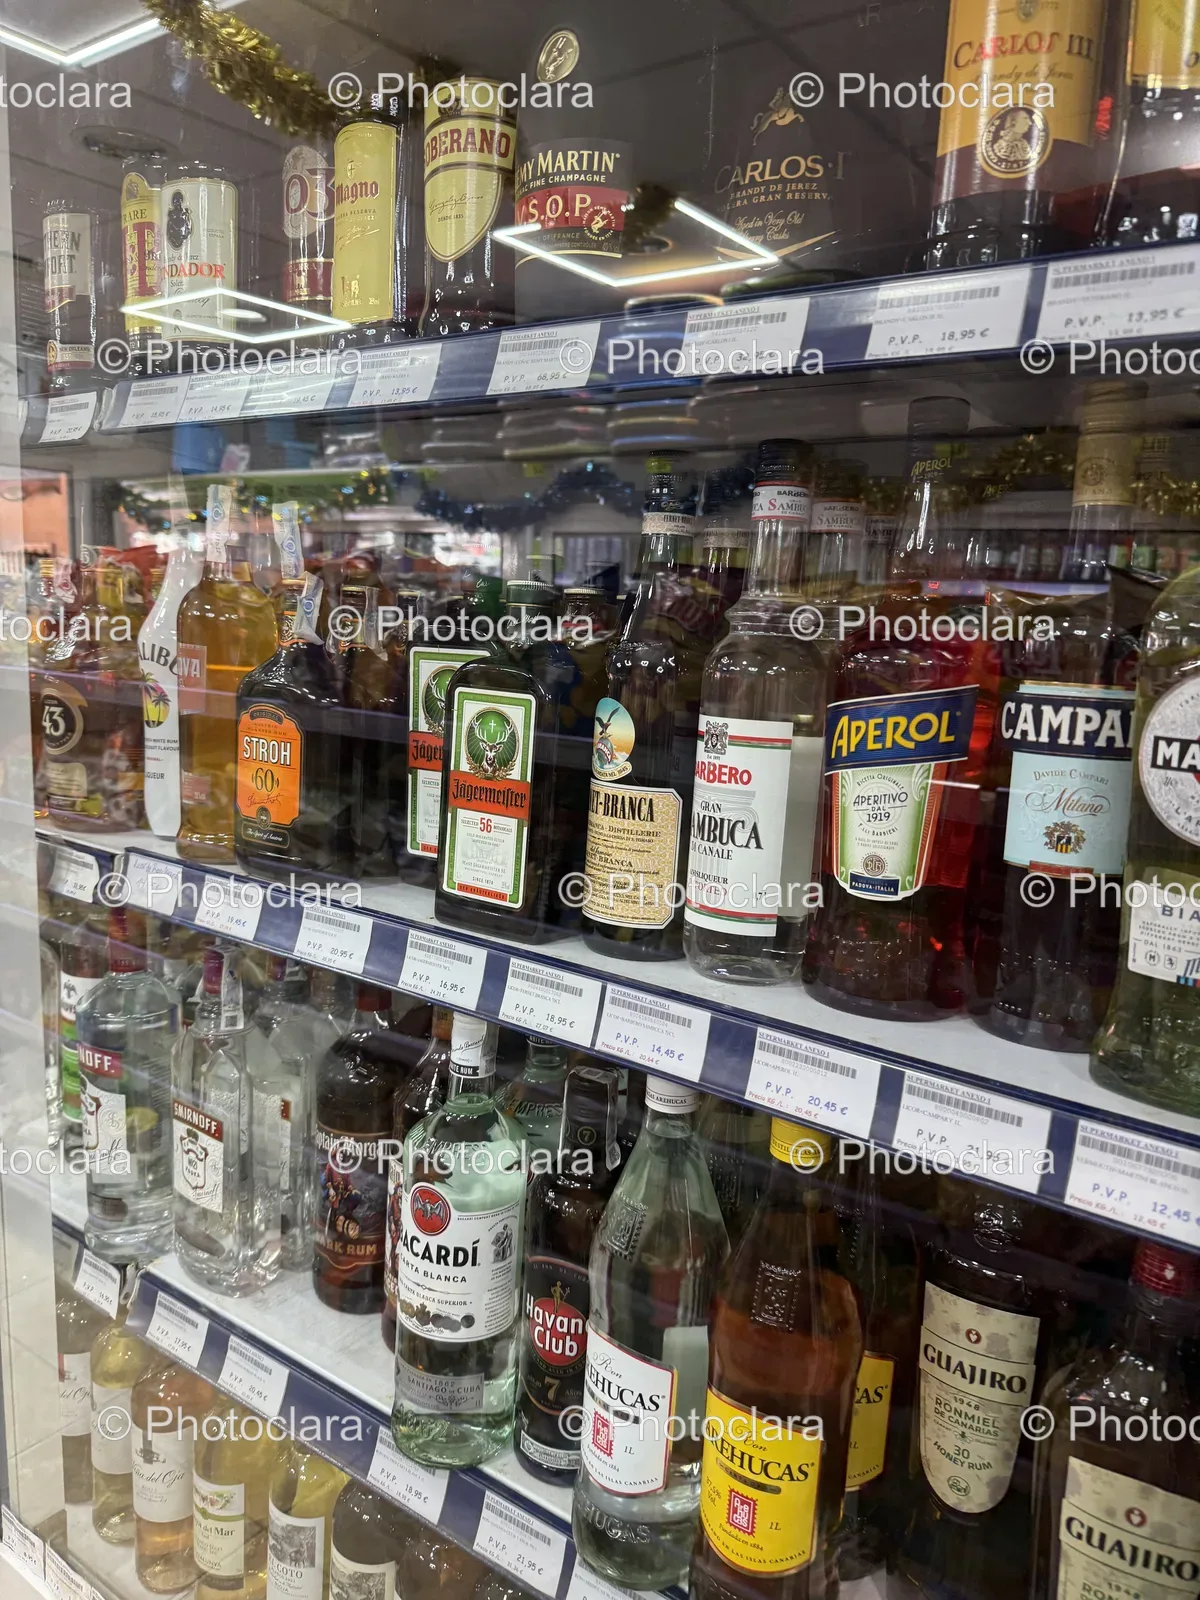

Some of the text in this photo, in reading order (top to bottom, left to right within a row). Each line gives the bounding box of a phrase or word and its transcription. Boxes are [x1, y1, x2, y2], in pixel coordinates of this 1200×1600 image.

[953, 31, 1095, 69] CARLOS III
[424, 127, 511, 166] OBERANO
[537, 150, 615, 176] MARTIN
[530, 173, 607, 191] FINE CHAMPAGNE
[714, 155, 825, 194] CARLOS
[730, 182, 818, 199] BRANDY DE JEREZ
[752, 193, 781, 204] GRAN
[123, 209, 148, 224] RARE
[764, 209, 805, 231] Very Old
[1064, 309, 1168, 328] P.V.P. 13,95
[888, 329, 976, 346] P.V.P. 18,95
[504, 373, 560, 383] P.V.P. 68,95
[362, 389, 381, 397] P.V.P.
[911, 457, 953, 477] APEROL
[831, 711, 956, 759] APEROL
[243, 735, 291, 766] STROH
[254, 767, 275, 793] 60
[856, 773, 904, 791] RICETTA ORIGINALE
[1033, 769, 1109, 786] DAVIDE CAMPARI
[700, 800, 722, 814] GRAN
[853, 792, 908, 807] APERITIVO
[1030, 787, 1110, 818] Milano
[461, 817, 492, 833] SELECTED 56
[867, 812, 891, 823] 1919
[608, 825, 661, 838] DISTILLERIE
[698, 844, 733, 860] CANALE
[205, 909, 221, 920] P.V.P.
[306, 940, 348, 958] P.V.P. 20,95
[1144, 939, 1159, 948] DAL
[511, 961, 561, 980] SUPERMARKET ANEXO
[412, 972, 459, 993] P.V.P. 16,95
[610, 988, 666, 1008] SUPERMARKET ANEXO
[514, 1003, 568, 1027] P.V.P. 18,95
[616, 1032, 676, 1061] P.V.P. 14,45
[758, 1031, 826, 1058] SUPERMARKET ANEXO
[460, 1066, 472, 1074] RUM
[766, 1082, 838, 1112] P.V.P. 20,45
[906, 1074, 986, 1103] SUPERMARKET ANEXO
[655, 1095, 688, 1106] AREHUCAS
[748, 1090, 812, 1118] Precio 20,45
[1080, 1124, 1172, 1156] SUPERMARKET ANEXO
[1068, 1192, 1093, 1208] Precio
[1092, 1182, 1191, 1223] P.V.P. 12,45
[346, 1244, 377, 1256] RUM
[423, 1271, 467, 1283] BLANCA
[437, 1298, 468, 1306] SUPERIOR
[534, 1327, 579, 1357] Club
[592, 1350, 623, 1380] Ron
[923, 1343, 1027, 1394] GUAJIRO
[407, 1376, 480, 1394] SANTIAGO CUBA
[544, 1375, 560, 1400] 7
[954, 1396, 980, 1411] 1948
[934, 1396, 1000, 1430] RONMIEL
[934, 1407, 1000, 1437] DE CANARIAS
[624, 1445, 634, 1455] 1L
[706, 1421, 810, 1482] AREHUCAS
[933, 1441, 994, 1470] HONEY RUM
[954, 1444, 970, 1460] 30
[145, 1472, 160, 1484] del
[380, 1468, 423, 1500] P.V.P. 18,95
[606, 1476, 658, 1486] ISLAS CANARIAS
[214, 1524, 235, 1538] Mar
[770, 1522, 782, 1531] 1L
[488, 1536, 536, 1571] P.V.P. 21,95
[732, 1550, 806, 1564] LAS ISLAS CANARIAS
[1065, 1516, 1199, 1582] GUAJIRO
[277, 1564, 304, 1580] COTO
